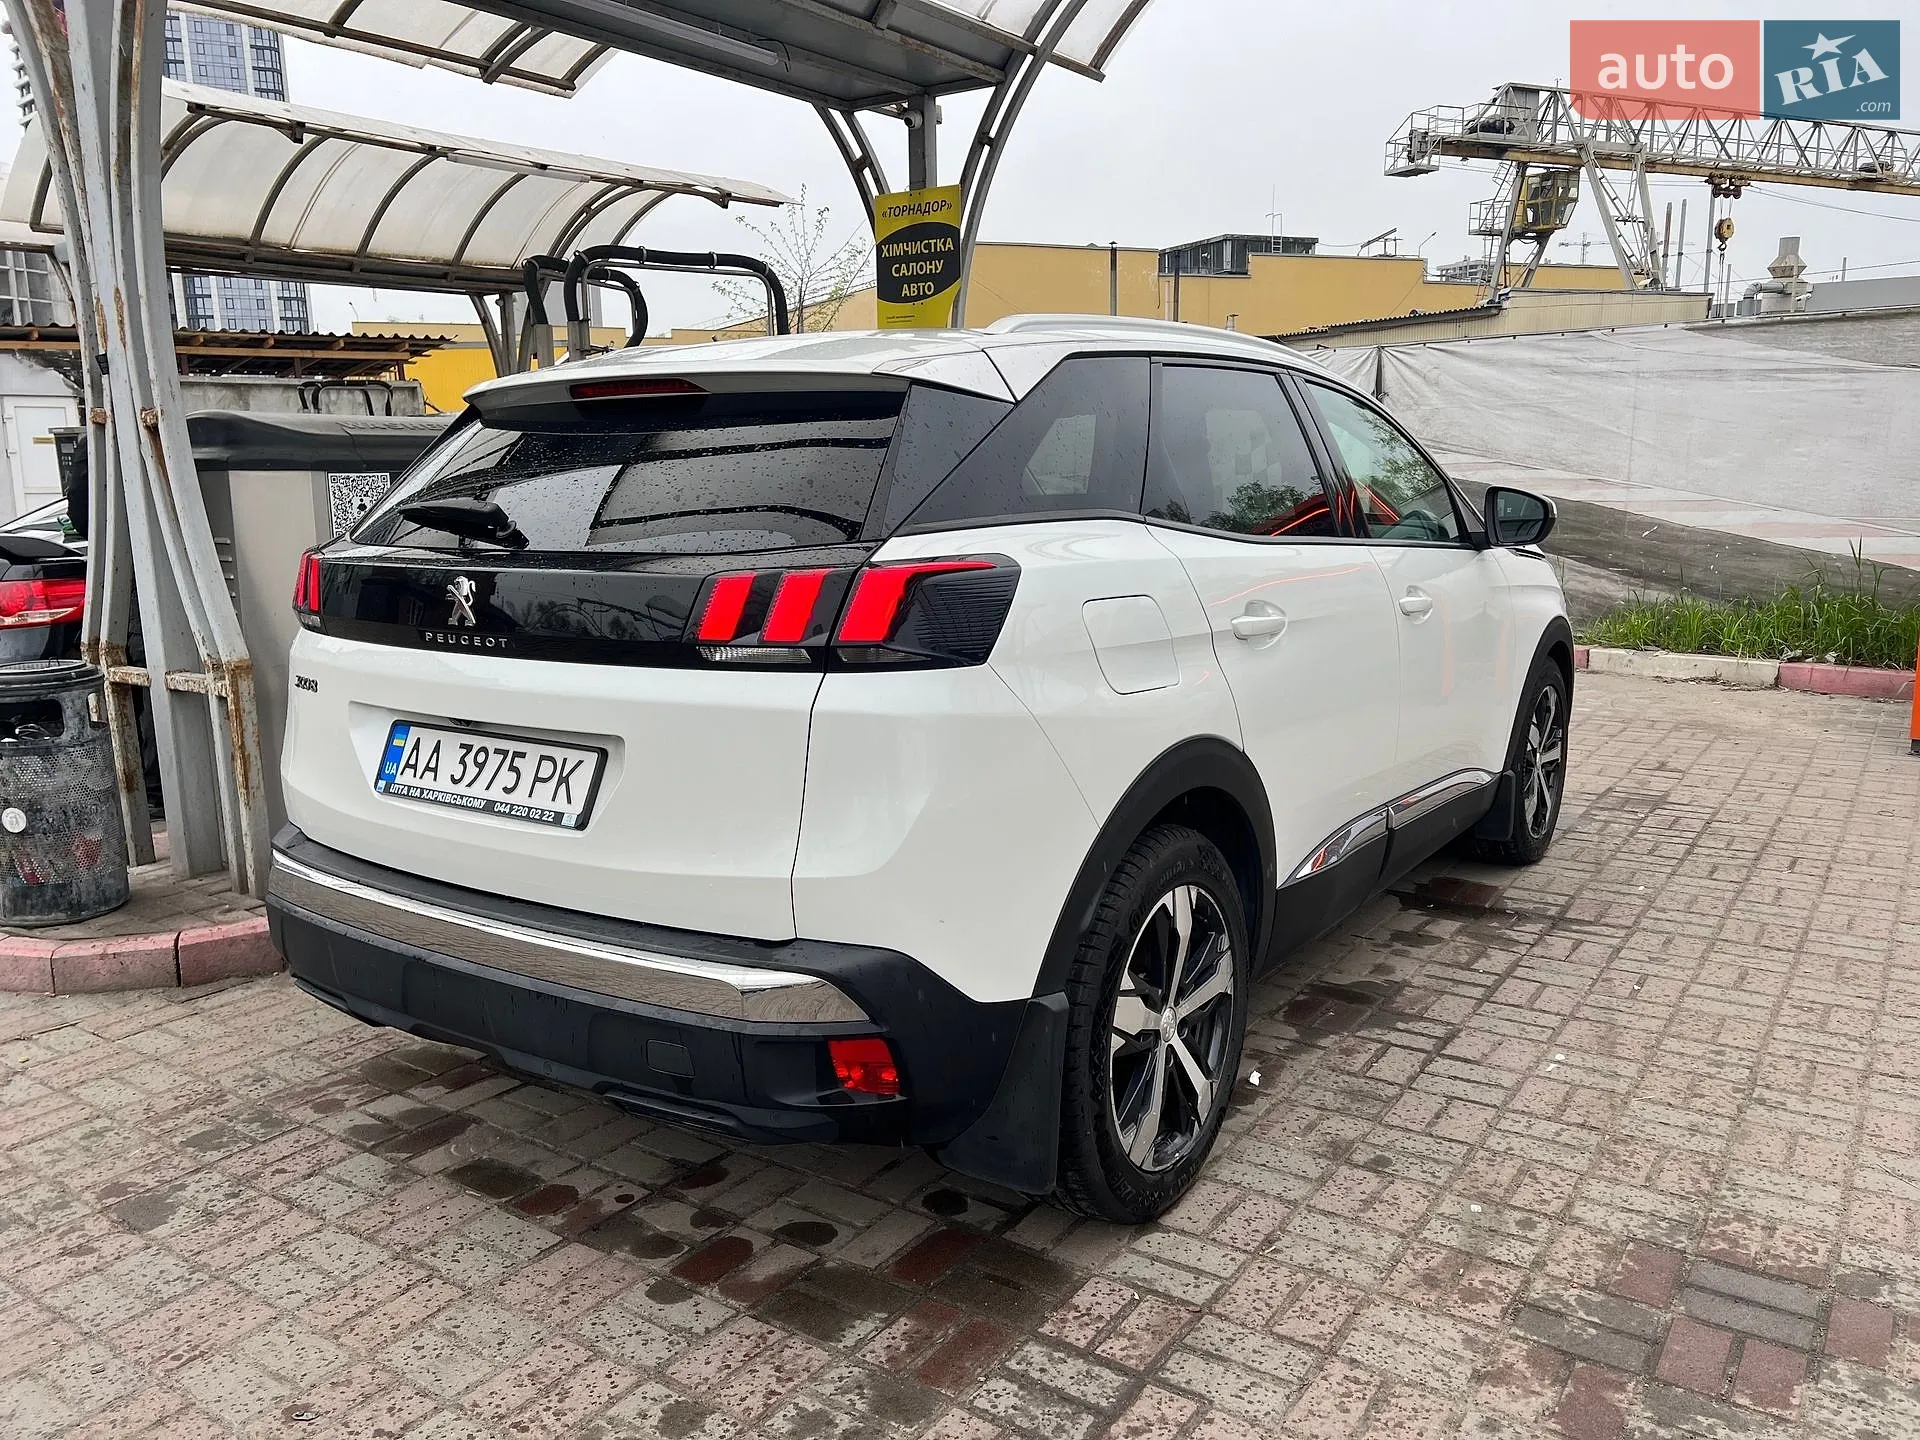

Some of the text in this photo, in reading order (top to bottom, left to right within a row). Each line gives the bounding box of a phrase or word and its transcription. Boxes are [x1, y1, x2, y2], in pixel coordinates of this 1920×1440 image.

[881, 199, 953, 219] «ТОРНАДОР»
[881, 237, 954, 258] ХІМЧИСТКА
[891, 260, 944, 277] САЛОНУ
[901, 281, 935, 297] АВТО
[425, 632, 508, 648] PEUGEOT
[384, 761, 397, 775] UA
[450, 743, 527, 795] 3975
[408, 787, 421, 798] НА
[420, 789, 487, 809] ХАРКІВСЬКОМУ
[493, 802, 555, 822] 044 220 02 22
